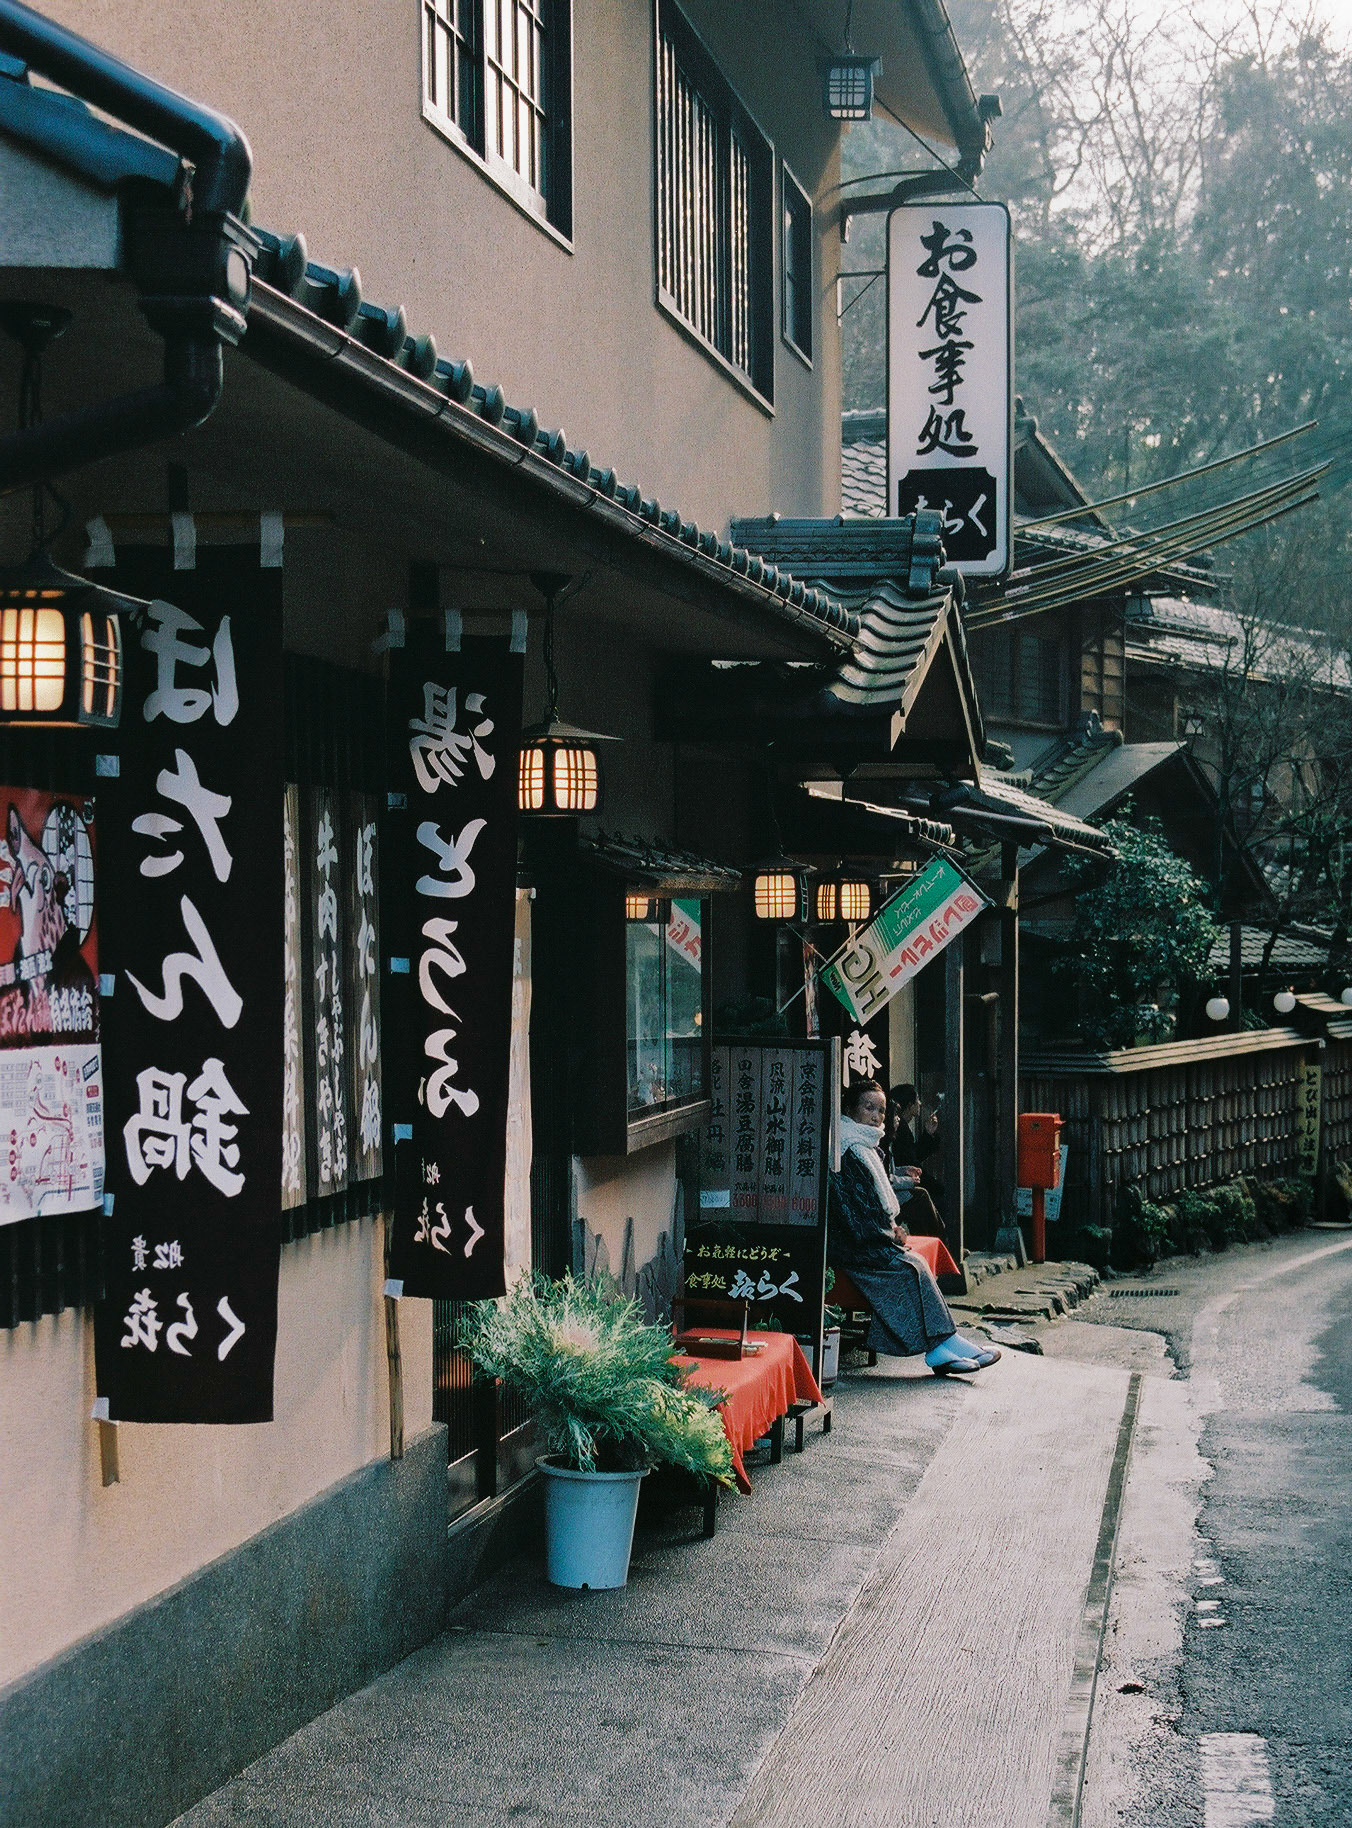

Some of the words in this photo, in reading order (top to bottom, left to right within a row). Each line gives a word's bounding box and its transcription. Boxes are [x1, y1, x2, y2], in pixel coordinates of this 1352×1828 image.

[915, 221, 983, 458] お食事処
[914, 494, 988, 537] らく
[316, 953, 333, 1187] すきやき
[697, 1244, 782, 1261] お気軽にどうぞ
[684, 1272, 727, 1289] 食事処
